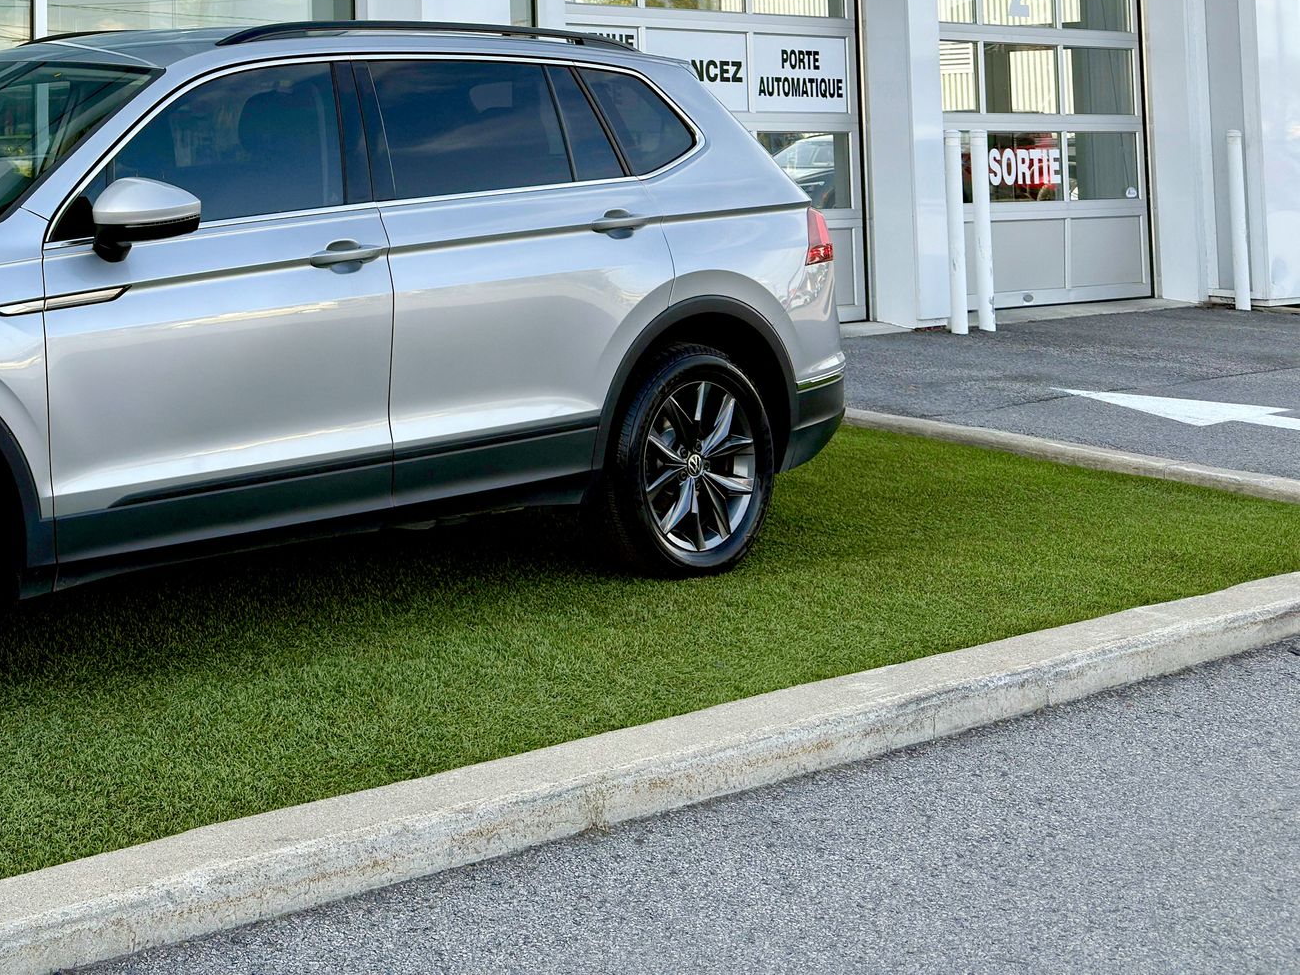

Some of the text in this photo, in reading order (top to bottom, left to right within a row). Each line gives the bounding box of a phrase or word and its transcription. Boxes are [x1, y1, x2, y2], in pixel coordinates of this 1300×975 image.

[781, 49, 820, 71] PORTE
[758, 76, 844, 99] AUTOMATIQUE
[989, 148, 1062, 186] SORTIE
